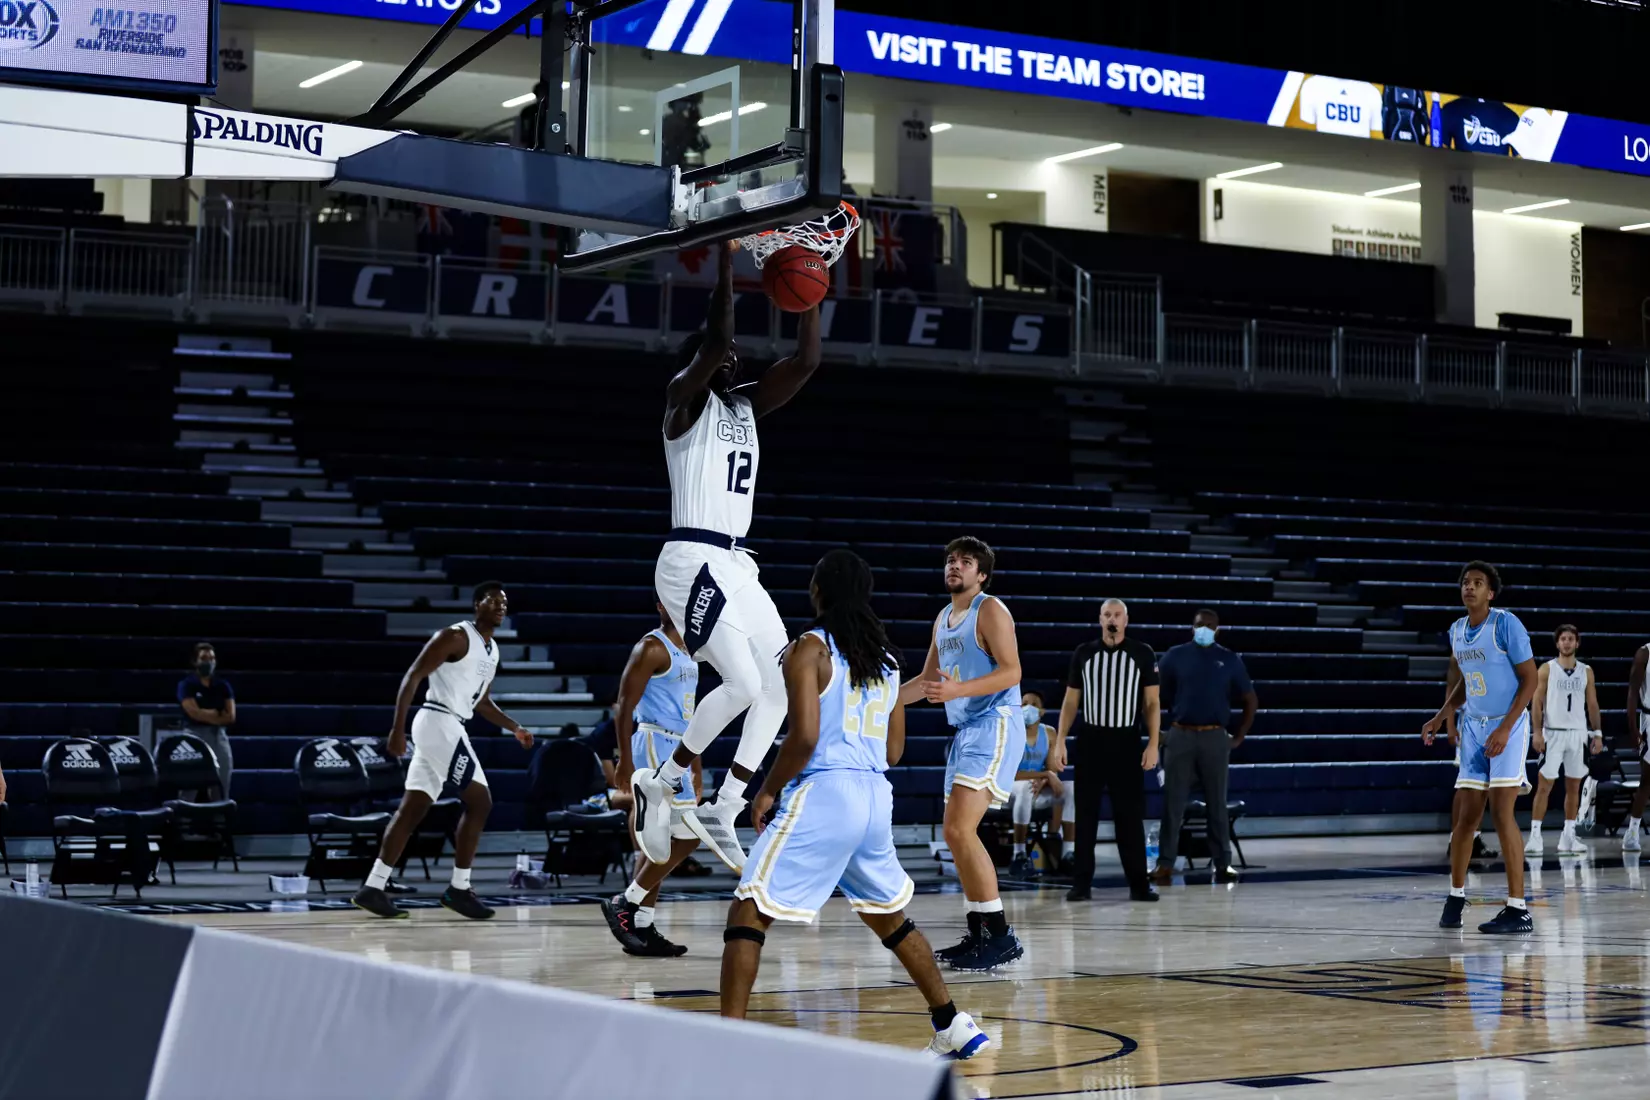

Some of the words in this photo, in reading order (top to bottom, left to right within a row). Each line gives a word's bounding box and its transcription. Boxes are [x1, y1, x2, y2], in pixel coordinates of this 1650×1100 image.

[90, 8, 177, 33] AM1350
[75, 37, 101, 51] SAN
[97, 28, 164, 46] RIVERSIDE
[866, 30, 947, 67] VISIT
[952, 41, 1012, 76] THE
[1018, 50, 1100, 87] TEAM
[1106, 63, 1206, 100] STORE!
[1325, 102, 1361, 123] CBU
[1478, 132, 1501, 147] CBU
[1624, 135, 1650, 162] LO
[1094, 174, 1106, 215] MEN
[1332, 224, 1362, 236] Student
[1367, 228, 1394, 239] Athlete
[1570, 232, 1581, 296] WOMEN
[727, 450, 752, 495] 12
[690, 585, 716, 636] LANCERS
[1456, 647, 1487, 664] HAWKS
[1466, 671, 1487, 697] 13
[843, 668, 891, 741] 22
[1567, 693, 1572, 712] 1
[62, 759, 100, 768] adidas
[170, 751, 203, 761] adidas
[314, 759, 350, 768] adidas
[451, 753, 470, 786] LANCERS
